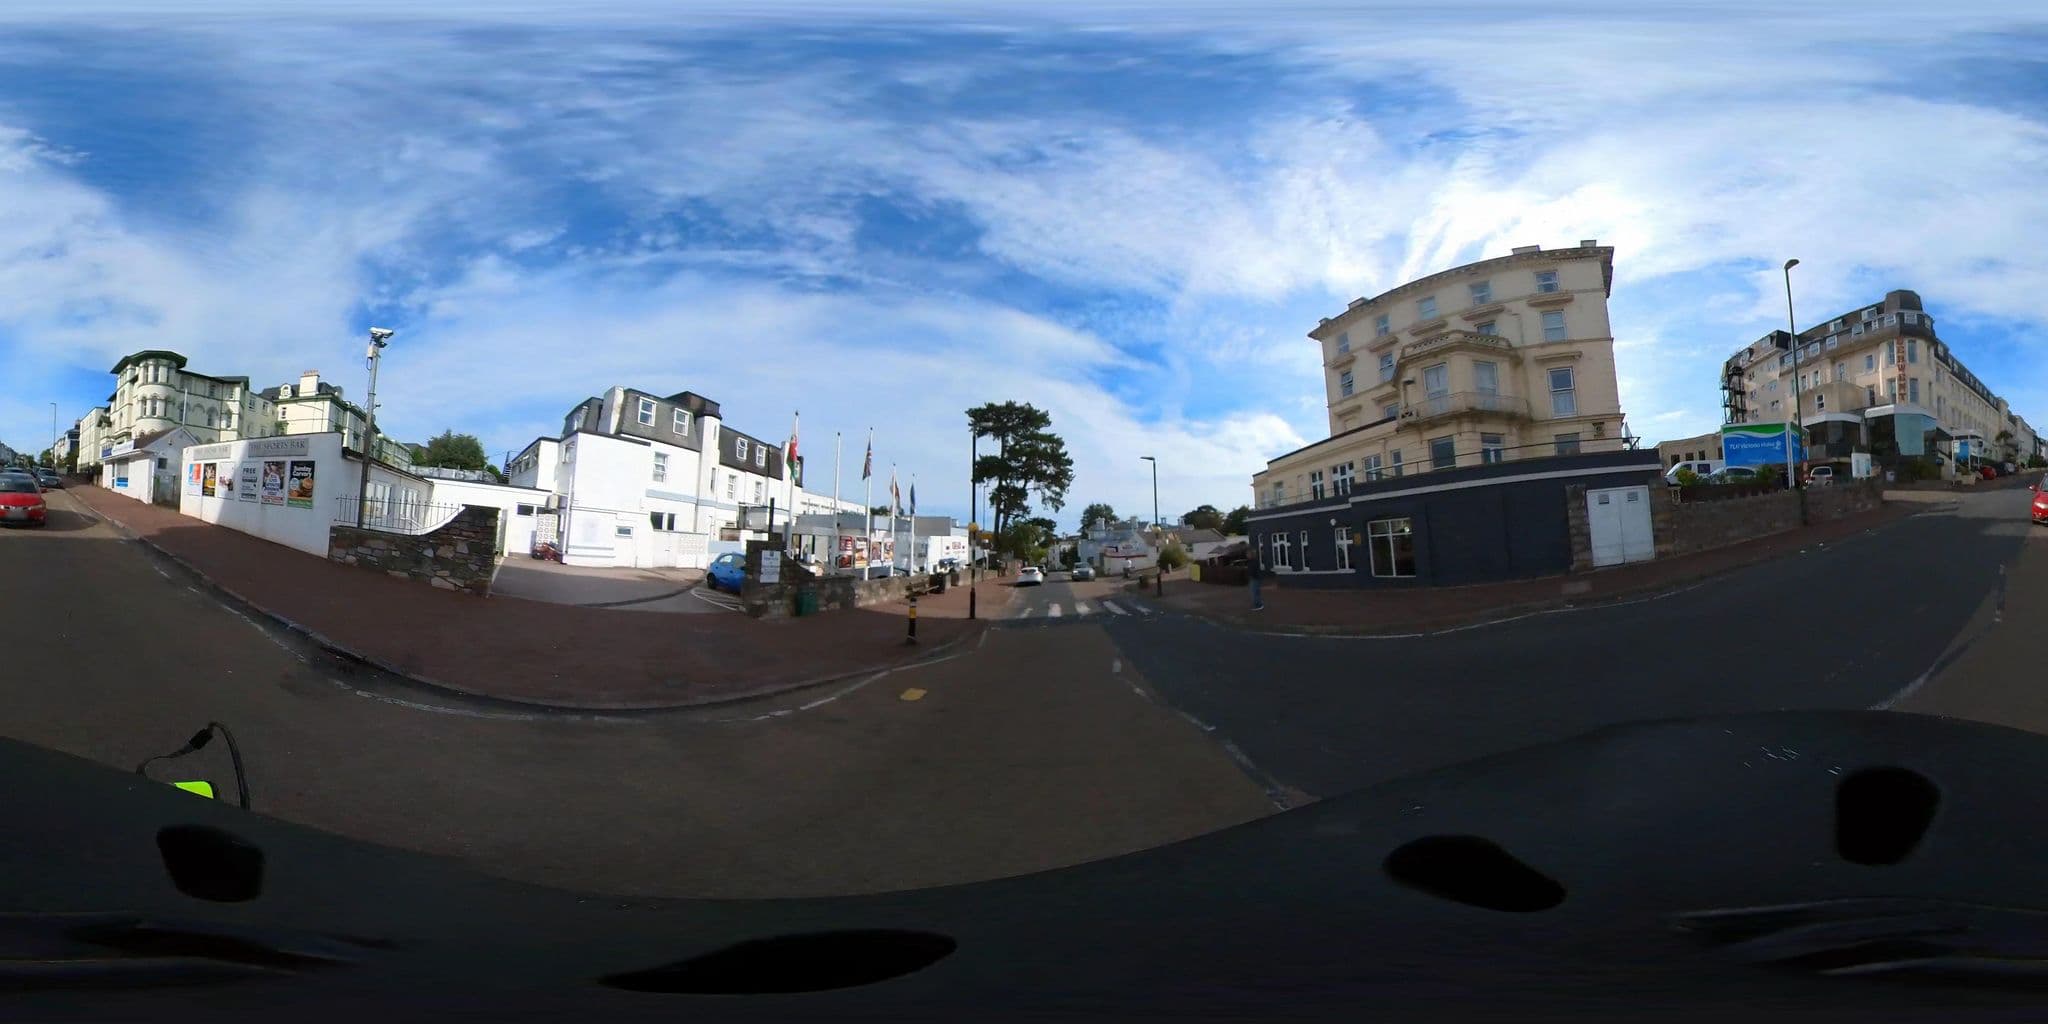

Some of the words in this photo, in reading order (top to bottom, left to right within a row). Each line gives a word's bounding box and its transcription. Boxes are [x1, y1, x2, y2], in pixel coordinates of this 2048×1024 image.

[1896, 336, 1907, 401] DERWENT
[264, 440, 288, 450] SPORTS
[290, 439, 305, 449] BAR
[292, 470, 312, 478] Carvery
